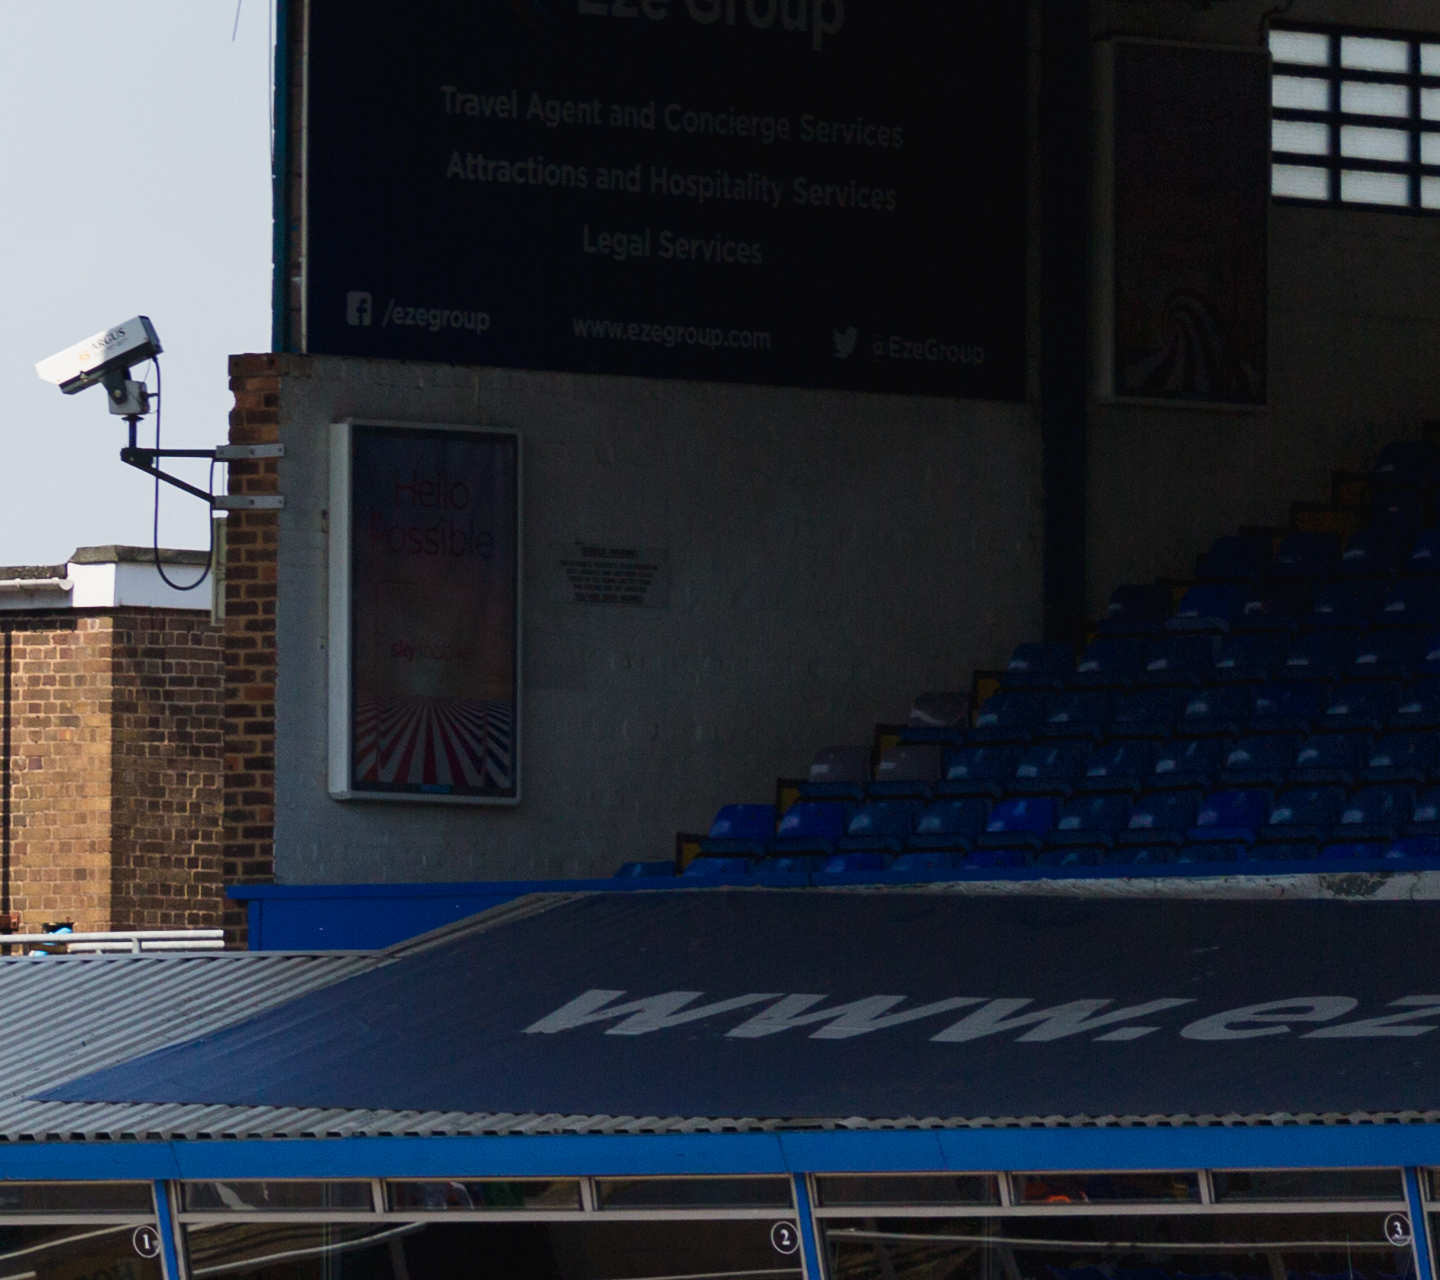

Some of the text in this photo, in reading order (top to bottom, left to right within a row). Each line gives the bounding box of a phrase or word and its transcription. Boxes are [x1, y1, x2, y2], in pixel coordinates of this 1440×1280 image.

[440, 85, 905, 149] Travel Agent and Concierge Services
[446, 152, 897, 212] Attractions and Hospitality Services
[582, 225, 763, 265] Legal Services
[382, 298, 490, 333] /ezegroup
[572, 316, 772, 352] www.ezegroup.com
[871, 334, 985, 368] @EzeGroup
[393, 468, 470, 511] Hello
[370, 511, 494, 558] Possible
[142, 1233, 150, 1249] 1
[780, 1229, 791, 1245] 2
[1393, 1221, 1403, 1238] 3
